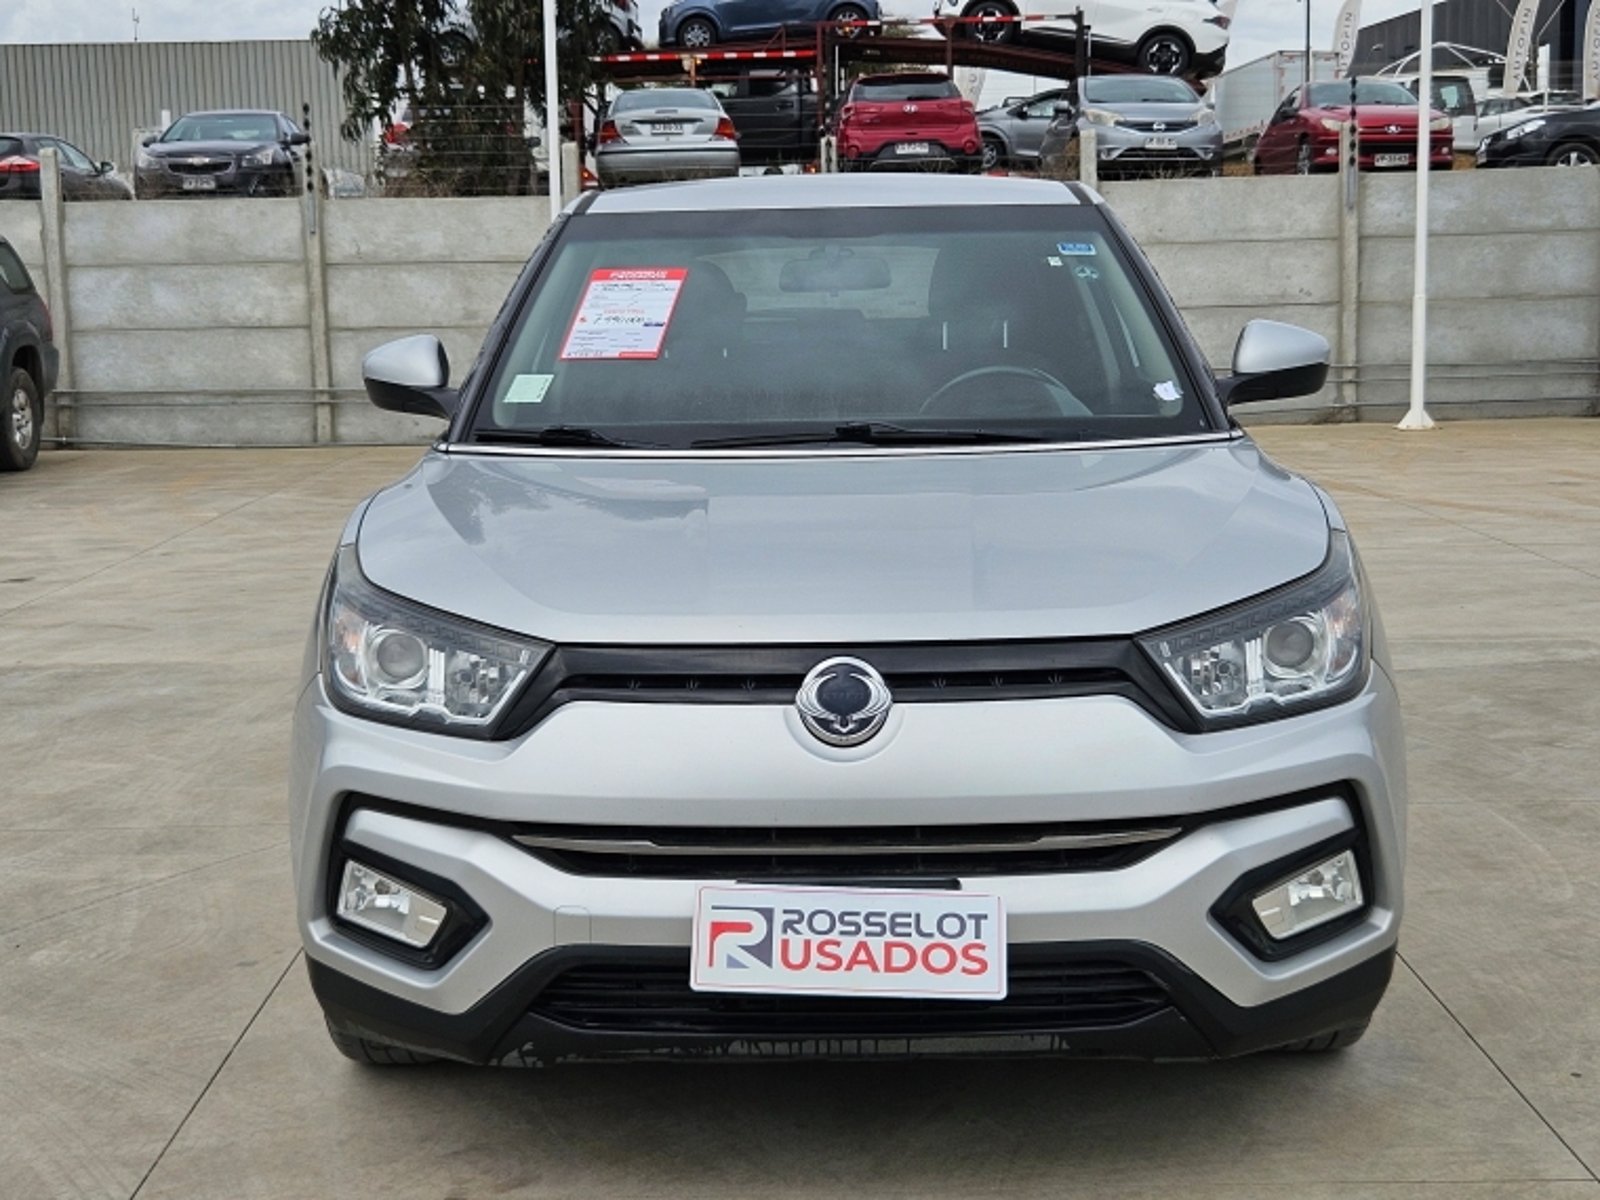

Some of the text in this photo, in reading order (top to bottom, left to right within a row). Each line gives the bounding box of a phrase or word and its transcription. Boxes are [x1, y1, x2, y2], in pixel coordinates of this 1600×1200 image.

[1513, 7, 1532, 81] AUTOFIN
[781, 908, 989, 940] ROSSELOT
[779, 937, 990, 976] USADOS
